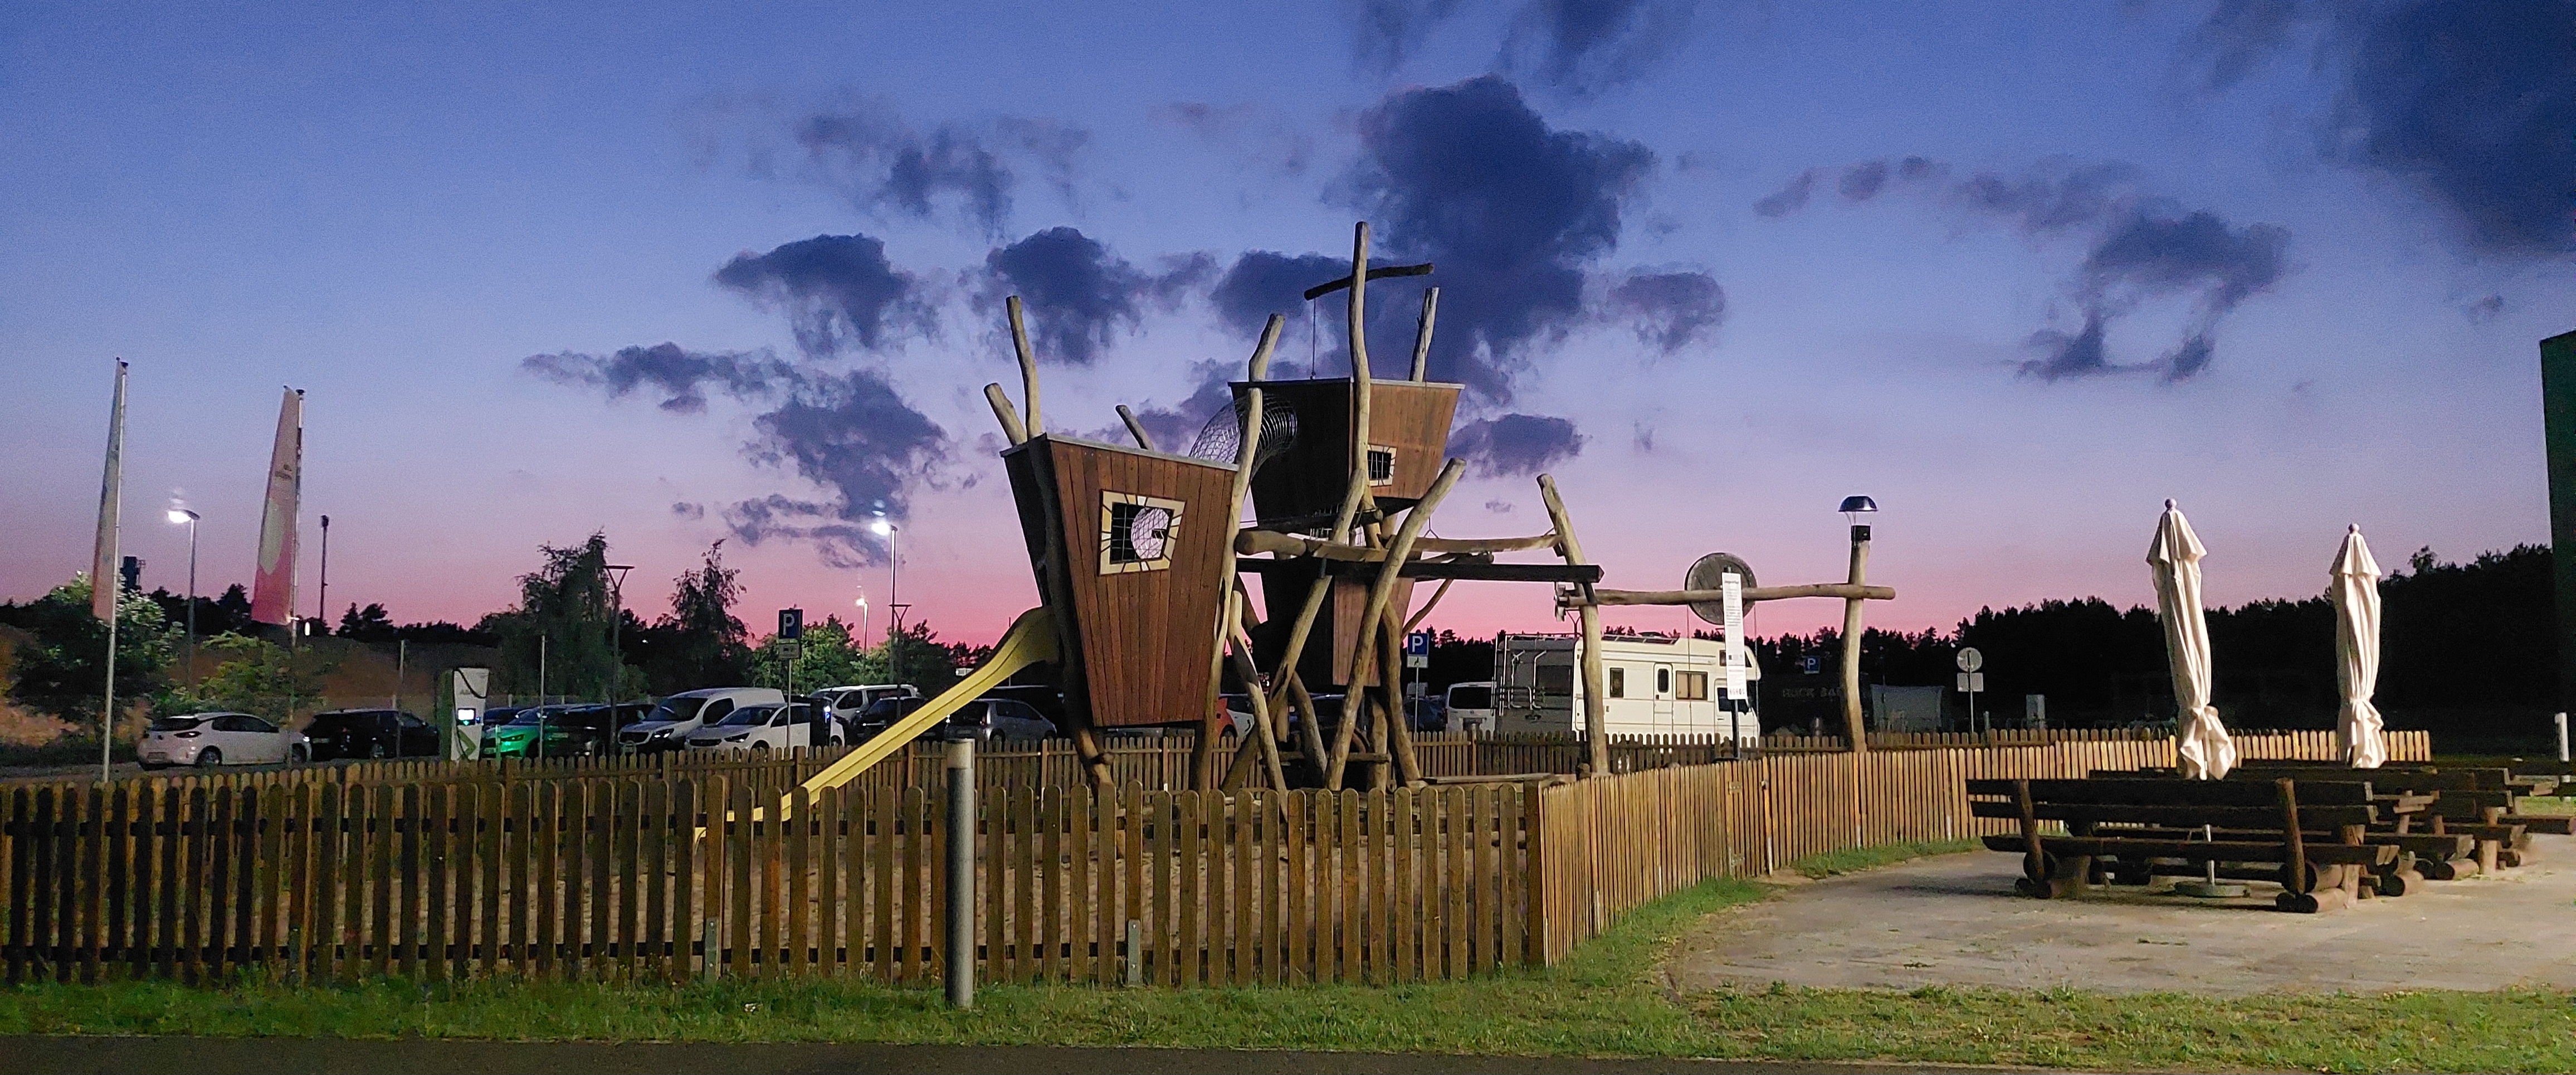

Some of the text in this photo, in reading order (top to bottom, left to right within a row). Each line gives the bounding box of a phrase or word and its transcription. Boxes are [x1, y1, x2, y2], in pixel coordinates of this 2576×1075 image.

[783, 614, 795, 636] P
[1412, 635, 1423, 653] P
[1807, 658, 1816, 669] P
